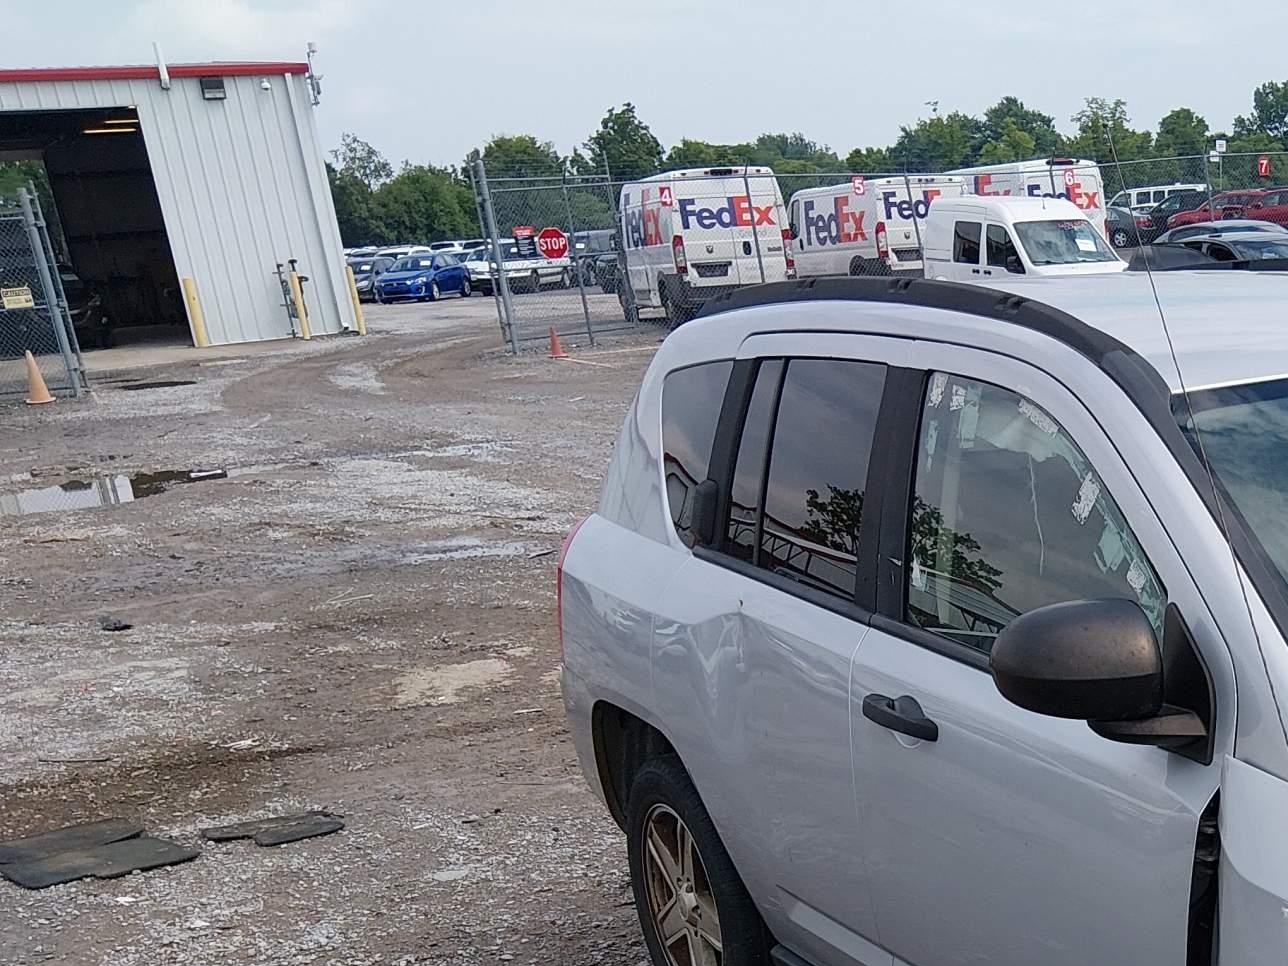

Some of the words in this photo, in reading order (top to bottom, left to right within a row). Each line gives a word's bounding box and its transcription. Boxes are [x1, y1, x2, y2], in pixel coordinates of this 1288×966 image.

[661, 188, 672, 205] 4
[853, 178, 864, 195] 5
[624, 189, 664, 248] FedEx
[678, 195, 776, 230] FedEx
[882, 189, 941, 220] Fed
[804, 195, 868, 247] FedEx
[540, 237, 566, 251] STOP
